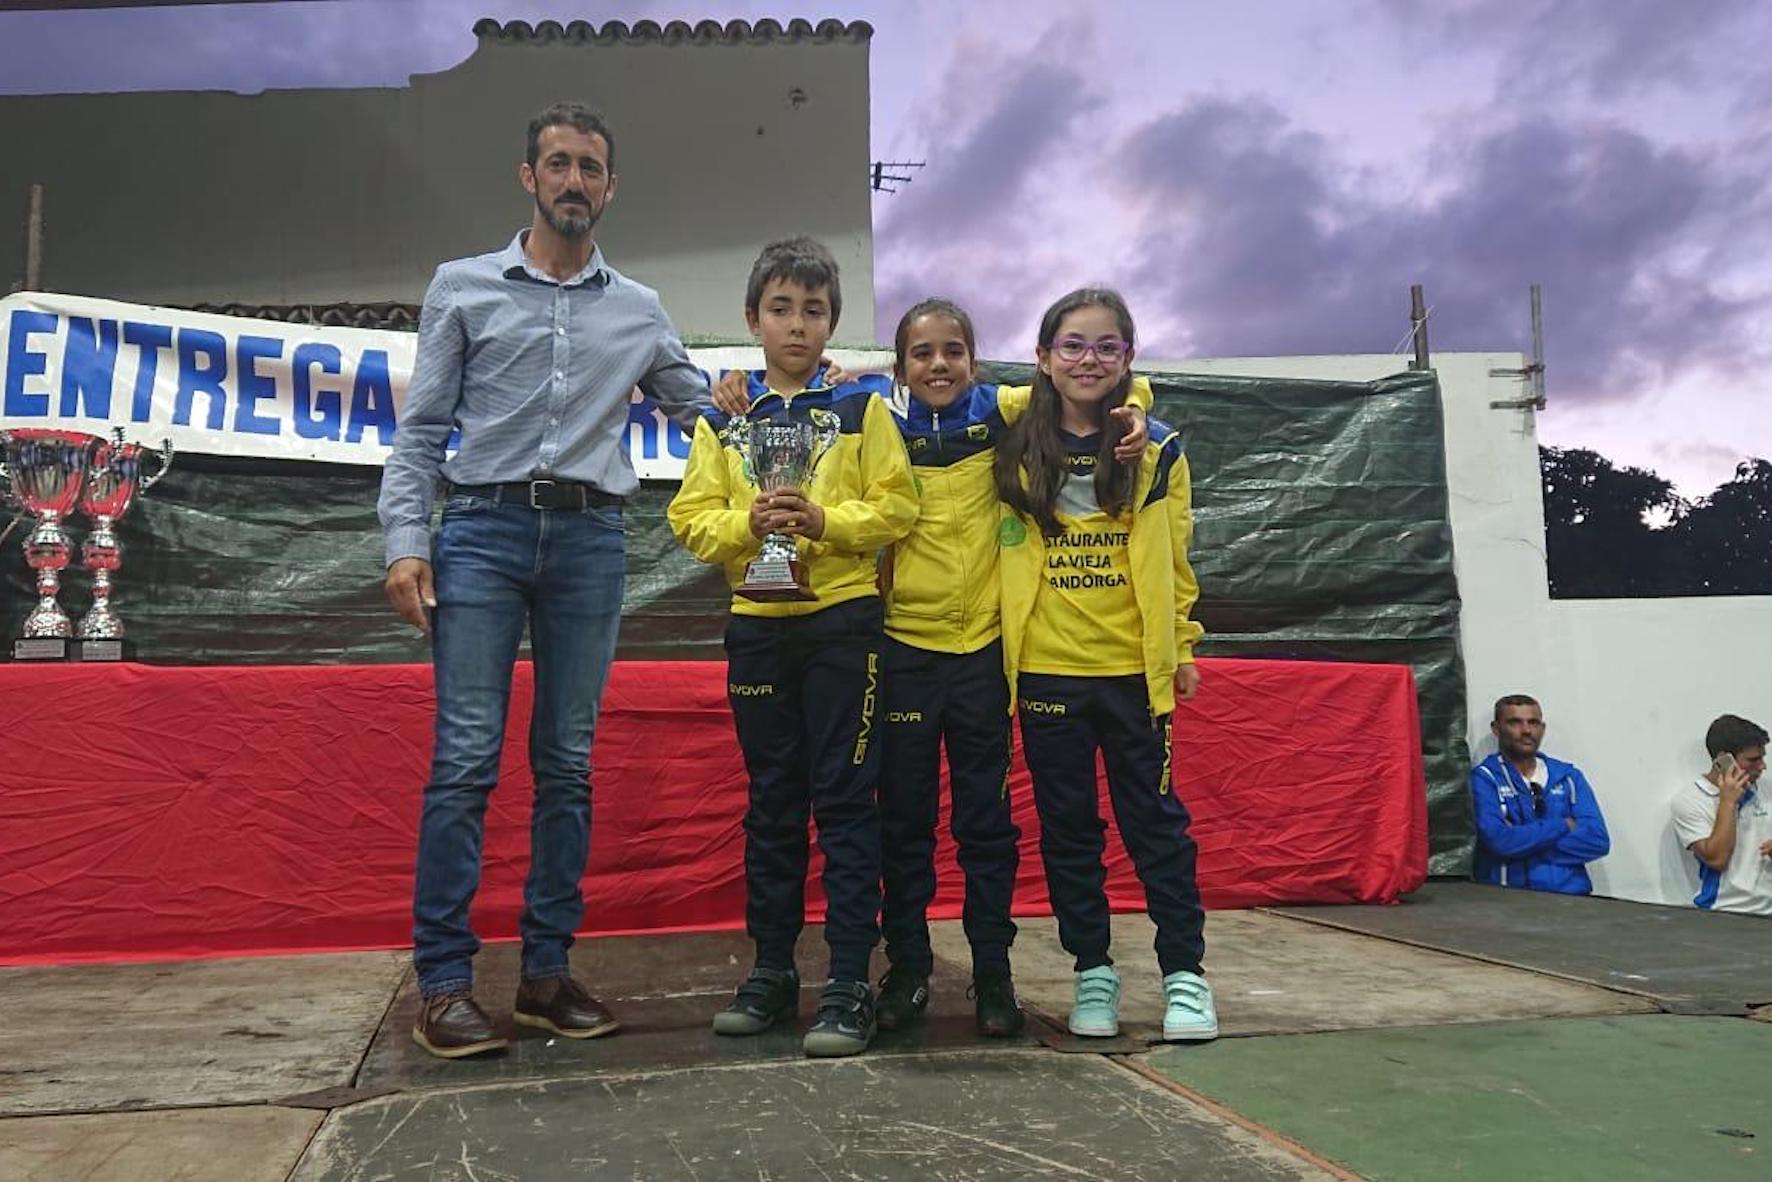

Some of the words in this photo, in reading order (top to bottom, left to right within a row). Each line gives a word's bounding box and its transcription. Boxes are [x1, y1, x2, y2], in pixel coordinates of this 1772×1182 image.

[3, 309, 398, 447] ENTREGA
[1043, 532, 1129, 548] STAURANTE
[1048, 555, 1066, 568] LA
[1069, 554, 1111, 568] VIEJA
[852, 652, 878, 765] GIVOVA
